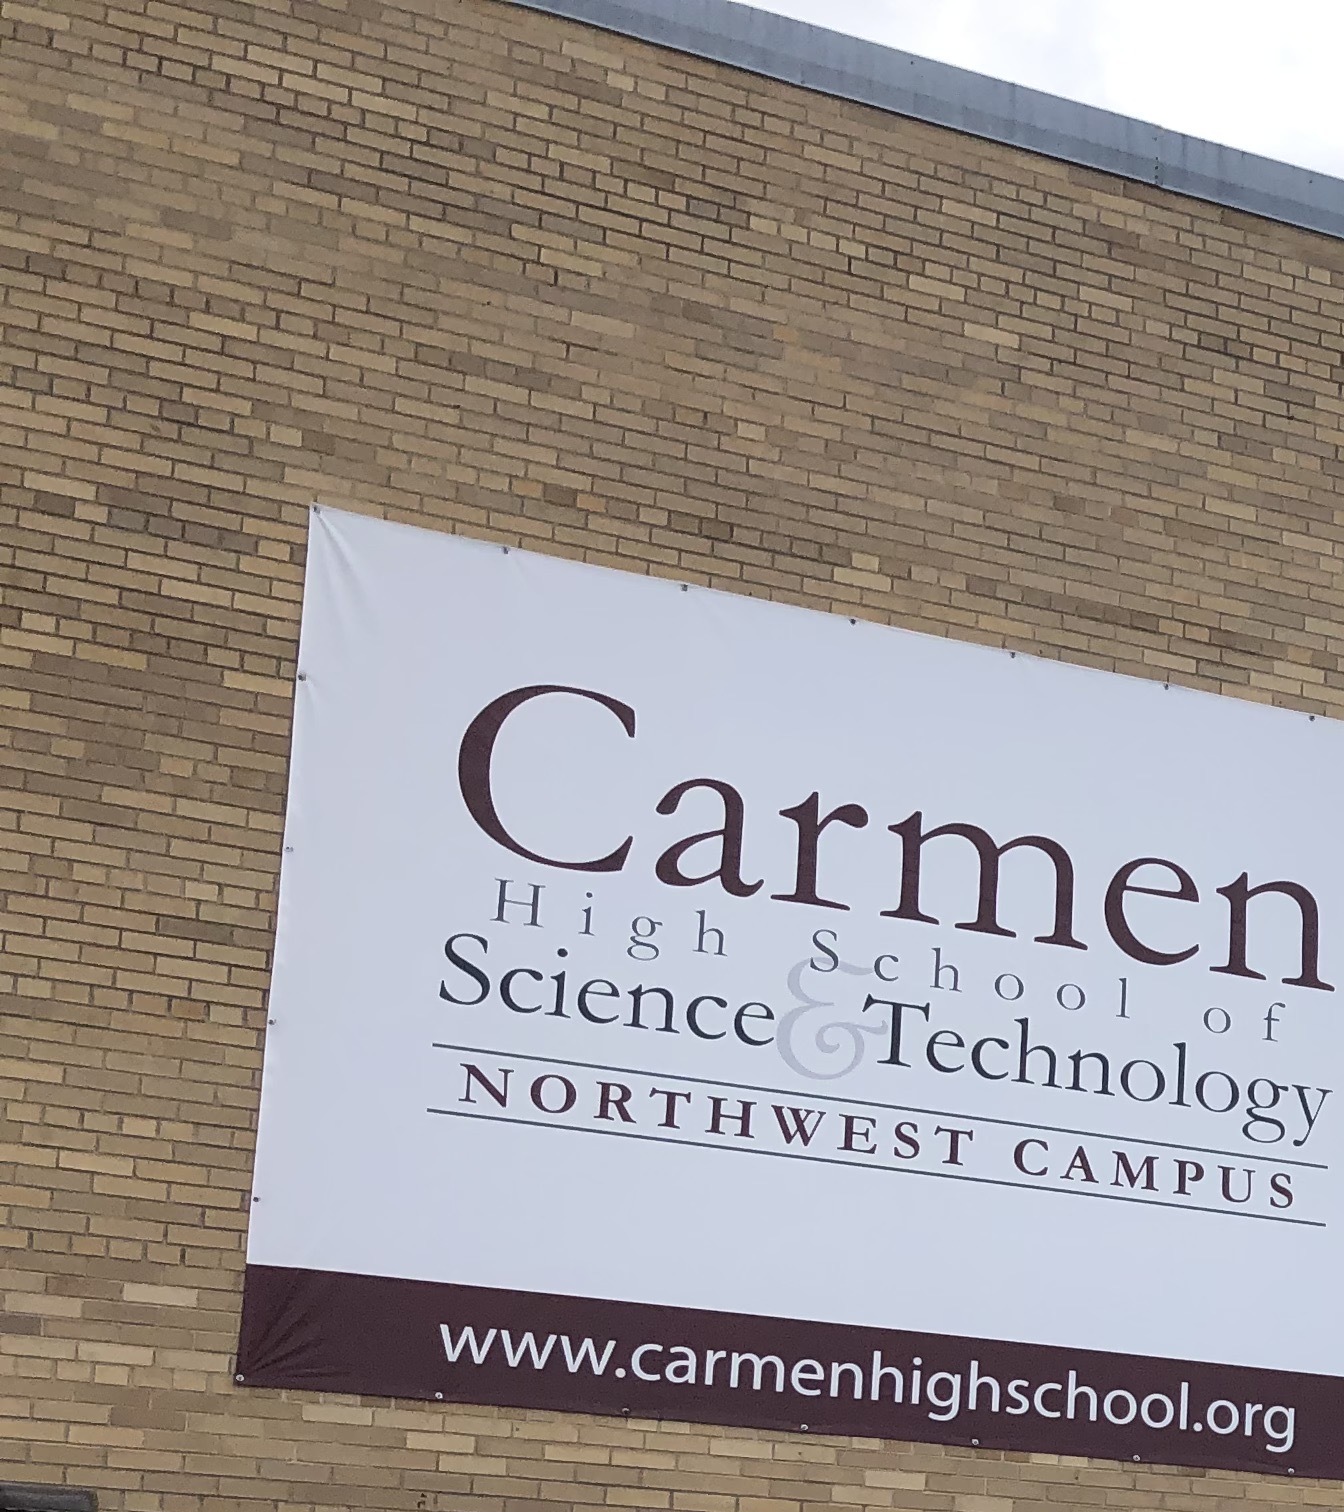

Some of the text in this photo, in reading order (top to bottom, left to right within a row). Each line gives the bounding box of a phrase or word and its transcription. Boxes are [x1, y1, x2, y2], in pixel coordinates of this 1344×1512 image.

[457, 683, 1336, 992] Carmen
[438, 932, 775, 1046] Science
[862, 993, 1333, 1146] Technology
[492, 876, 1289, 1043] High School of
[458, 1062, 1297, 1210] NORTHWEST CAMPUS
[439, 1319, 1297, 1451] www.carmenhighschool.org
